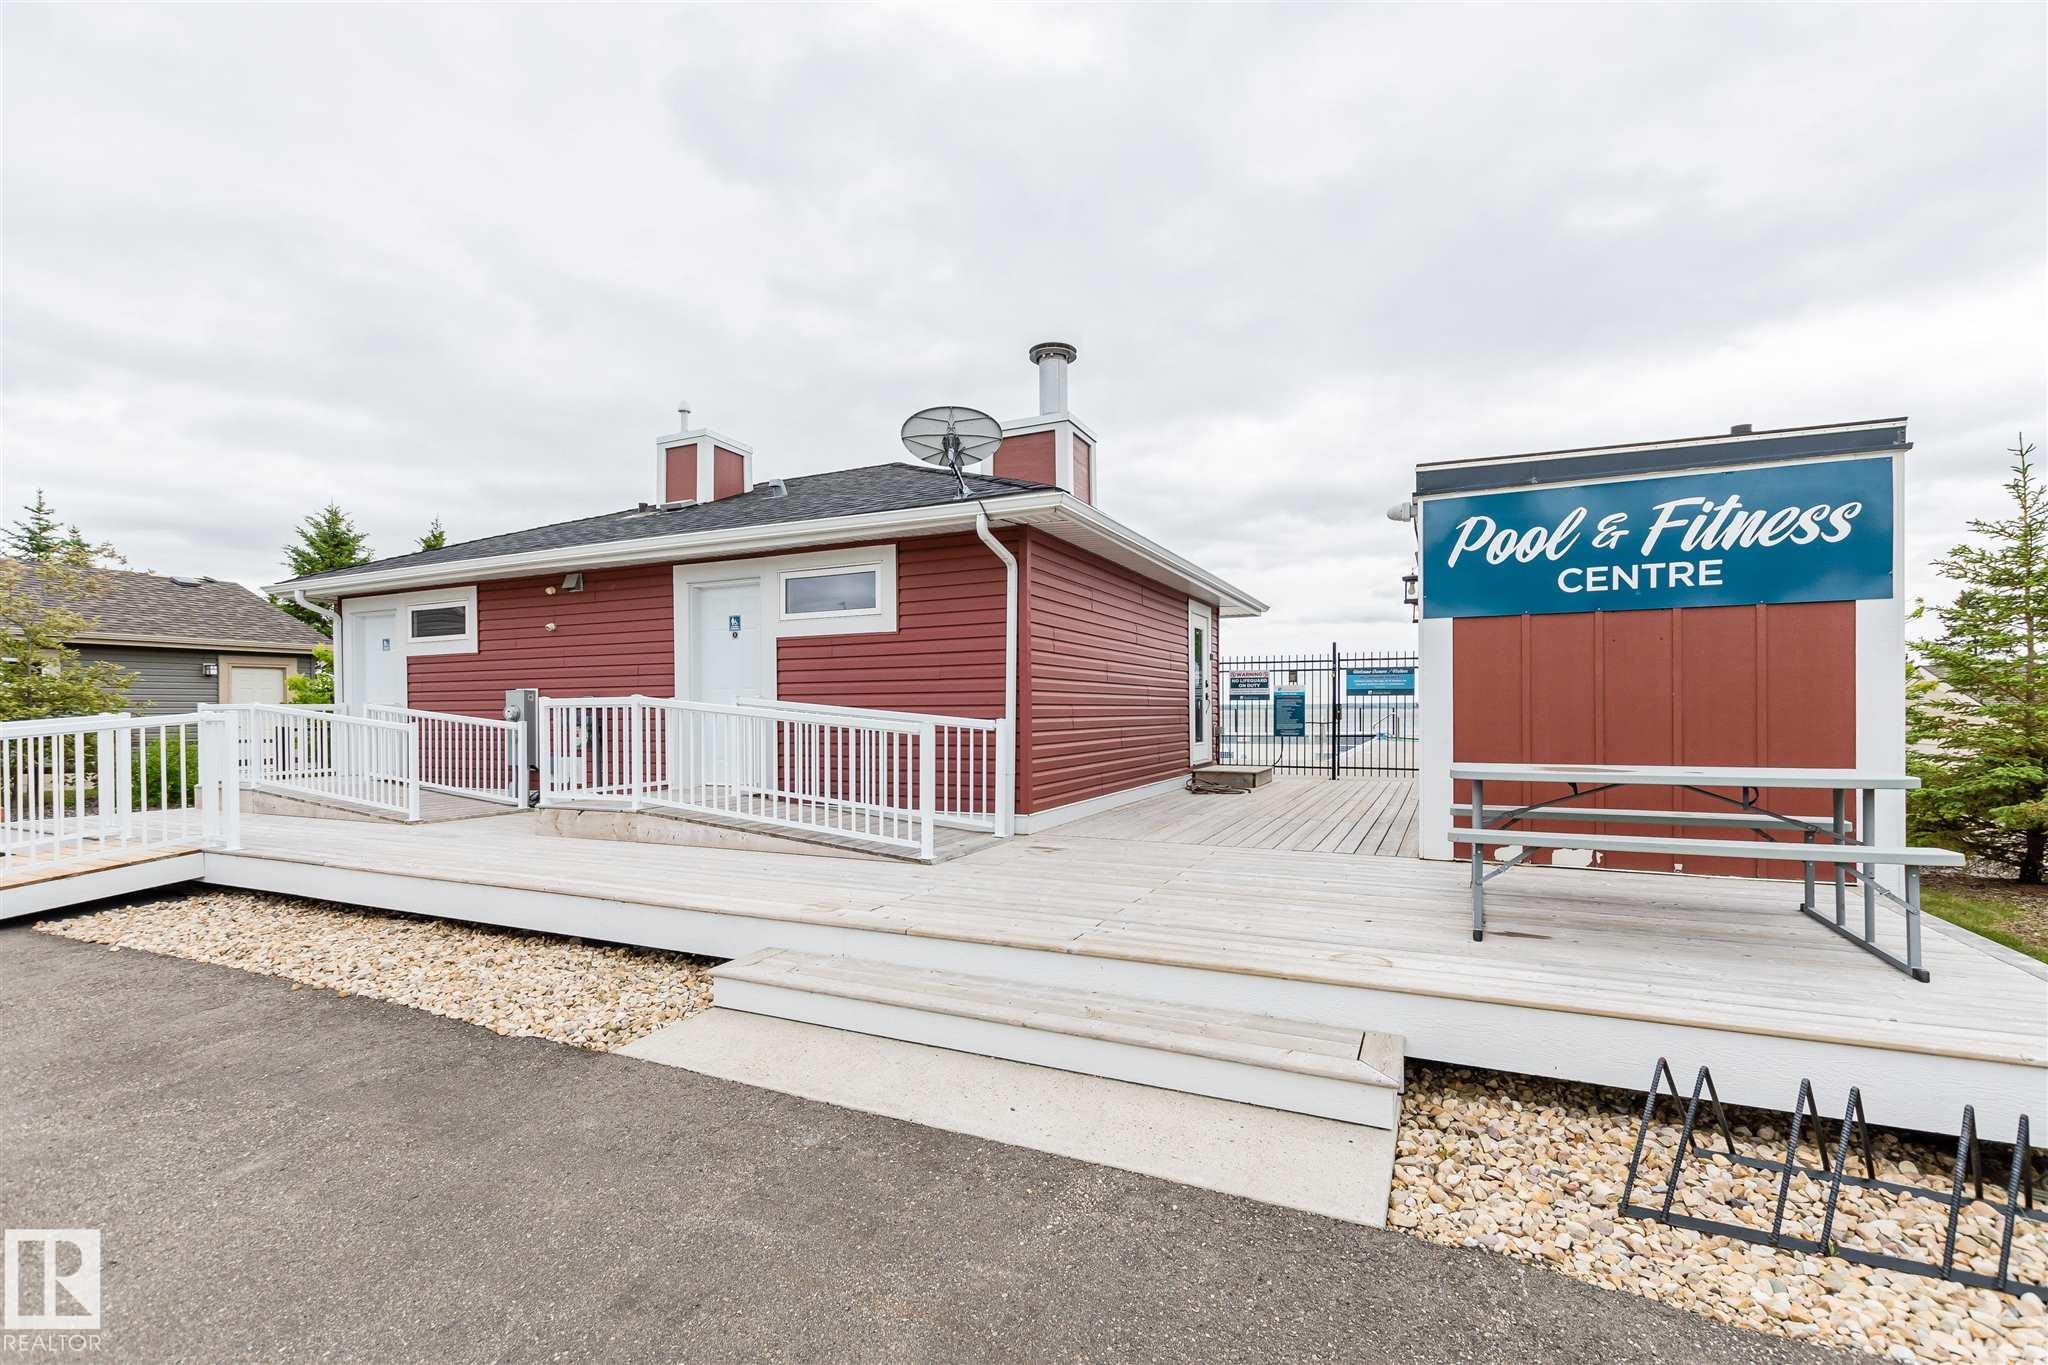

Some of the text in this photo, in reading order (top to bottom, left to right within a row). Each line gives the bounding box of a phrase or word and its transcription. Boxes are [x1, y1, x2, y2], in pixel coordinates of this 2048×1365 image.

[1448, 495, 1863, 568] Pool & Fitness
[1557, 559, 1723, 593] CENTRE
